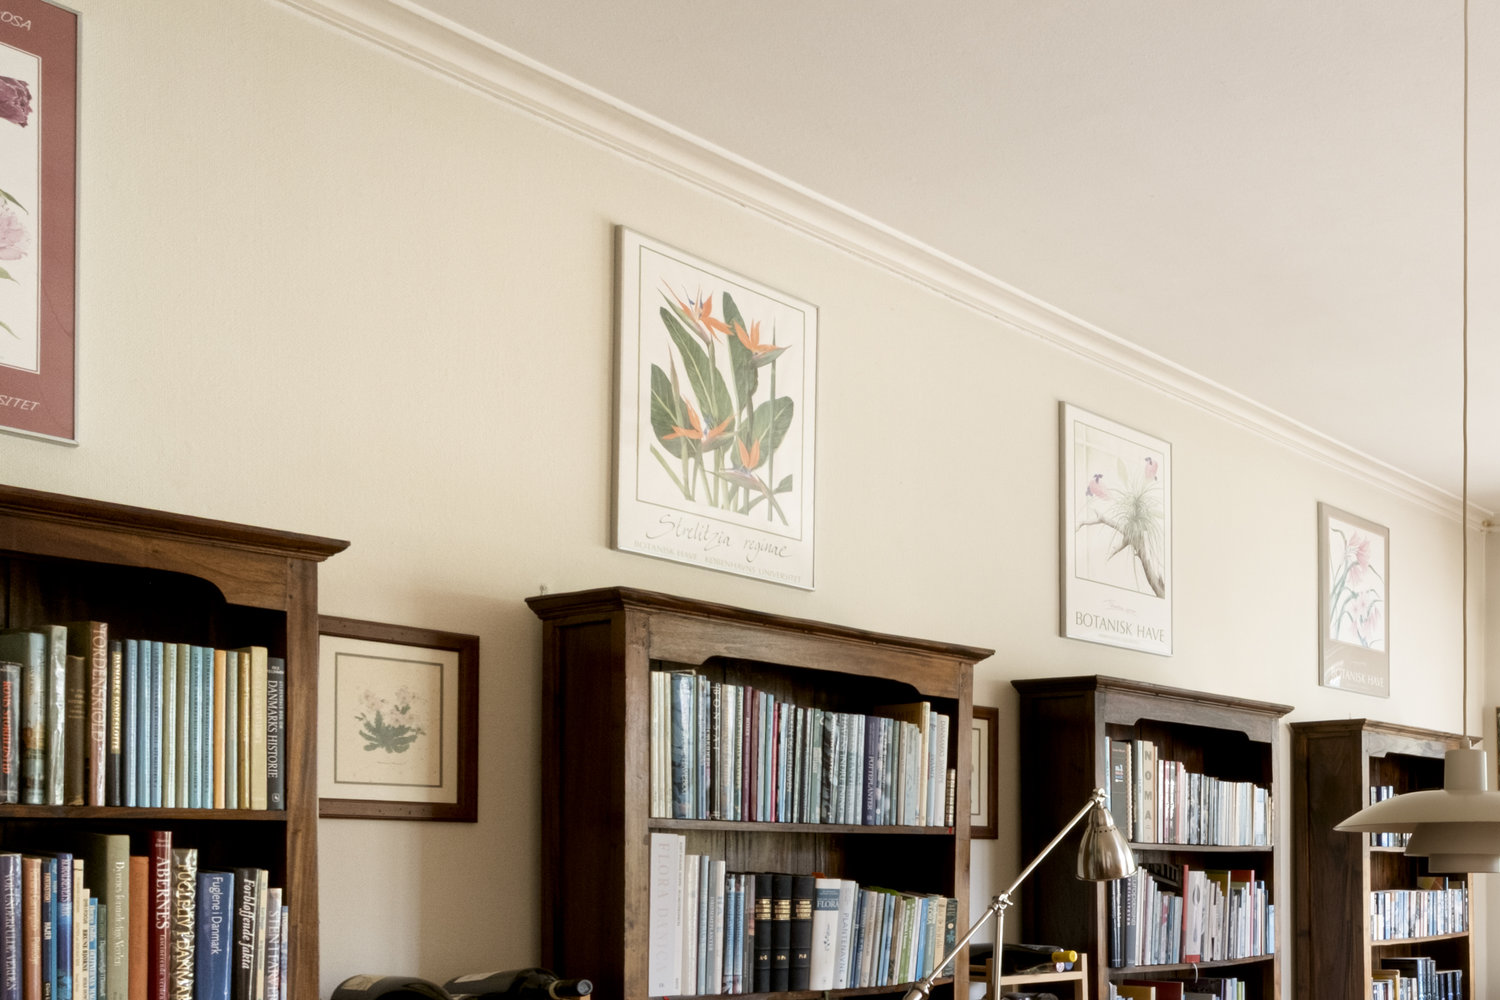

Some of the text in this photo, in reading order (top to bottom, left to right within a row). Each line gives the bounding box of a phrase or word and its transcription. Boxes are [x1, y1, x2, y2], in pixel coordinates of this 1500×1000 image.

[0, 11, 32, 32] OSA
[645, 513, 793, 563] Strelitzia reginae
[1075, 611, 1165, 642] BOTANISK HAVE
[1367, 674, 1384, 688] HAVE
[267, 680, 279, 732] DANMARKS
[267, 734, 279, 778] HISTORIE
[1144, 750, 1153, 820] NOMA
[112, 861, 126, 893] Dyrenes
[657, 842, 671, 899] FLORA
[156, 857, 170, 929] ABERNES
[177, 864, 193, 928] FUGLELIV
[209, 876, 224, 910] Fuglene
[817, 900, 840, 908] FLORA
[44, 921, 52, 940] HAJER
[211, 915, 223, 955] Danmark
[267, 910, 280, 943] STEN
[113, 940, 125, 967] Verden
[237, 941, 254, 970] fakta
